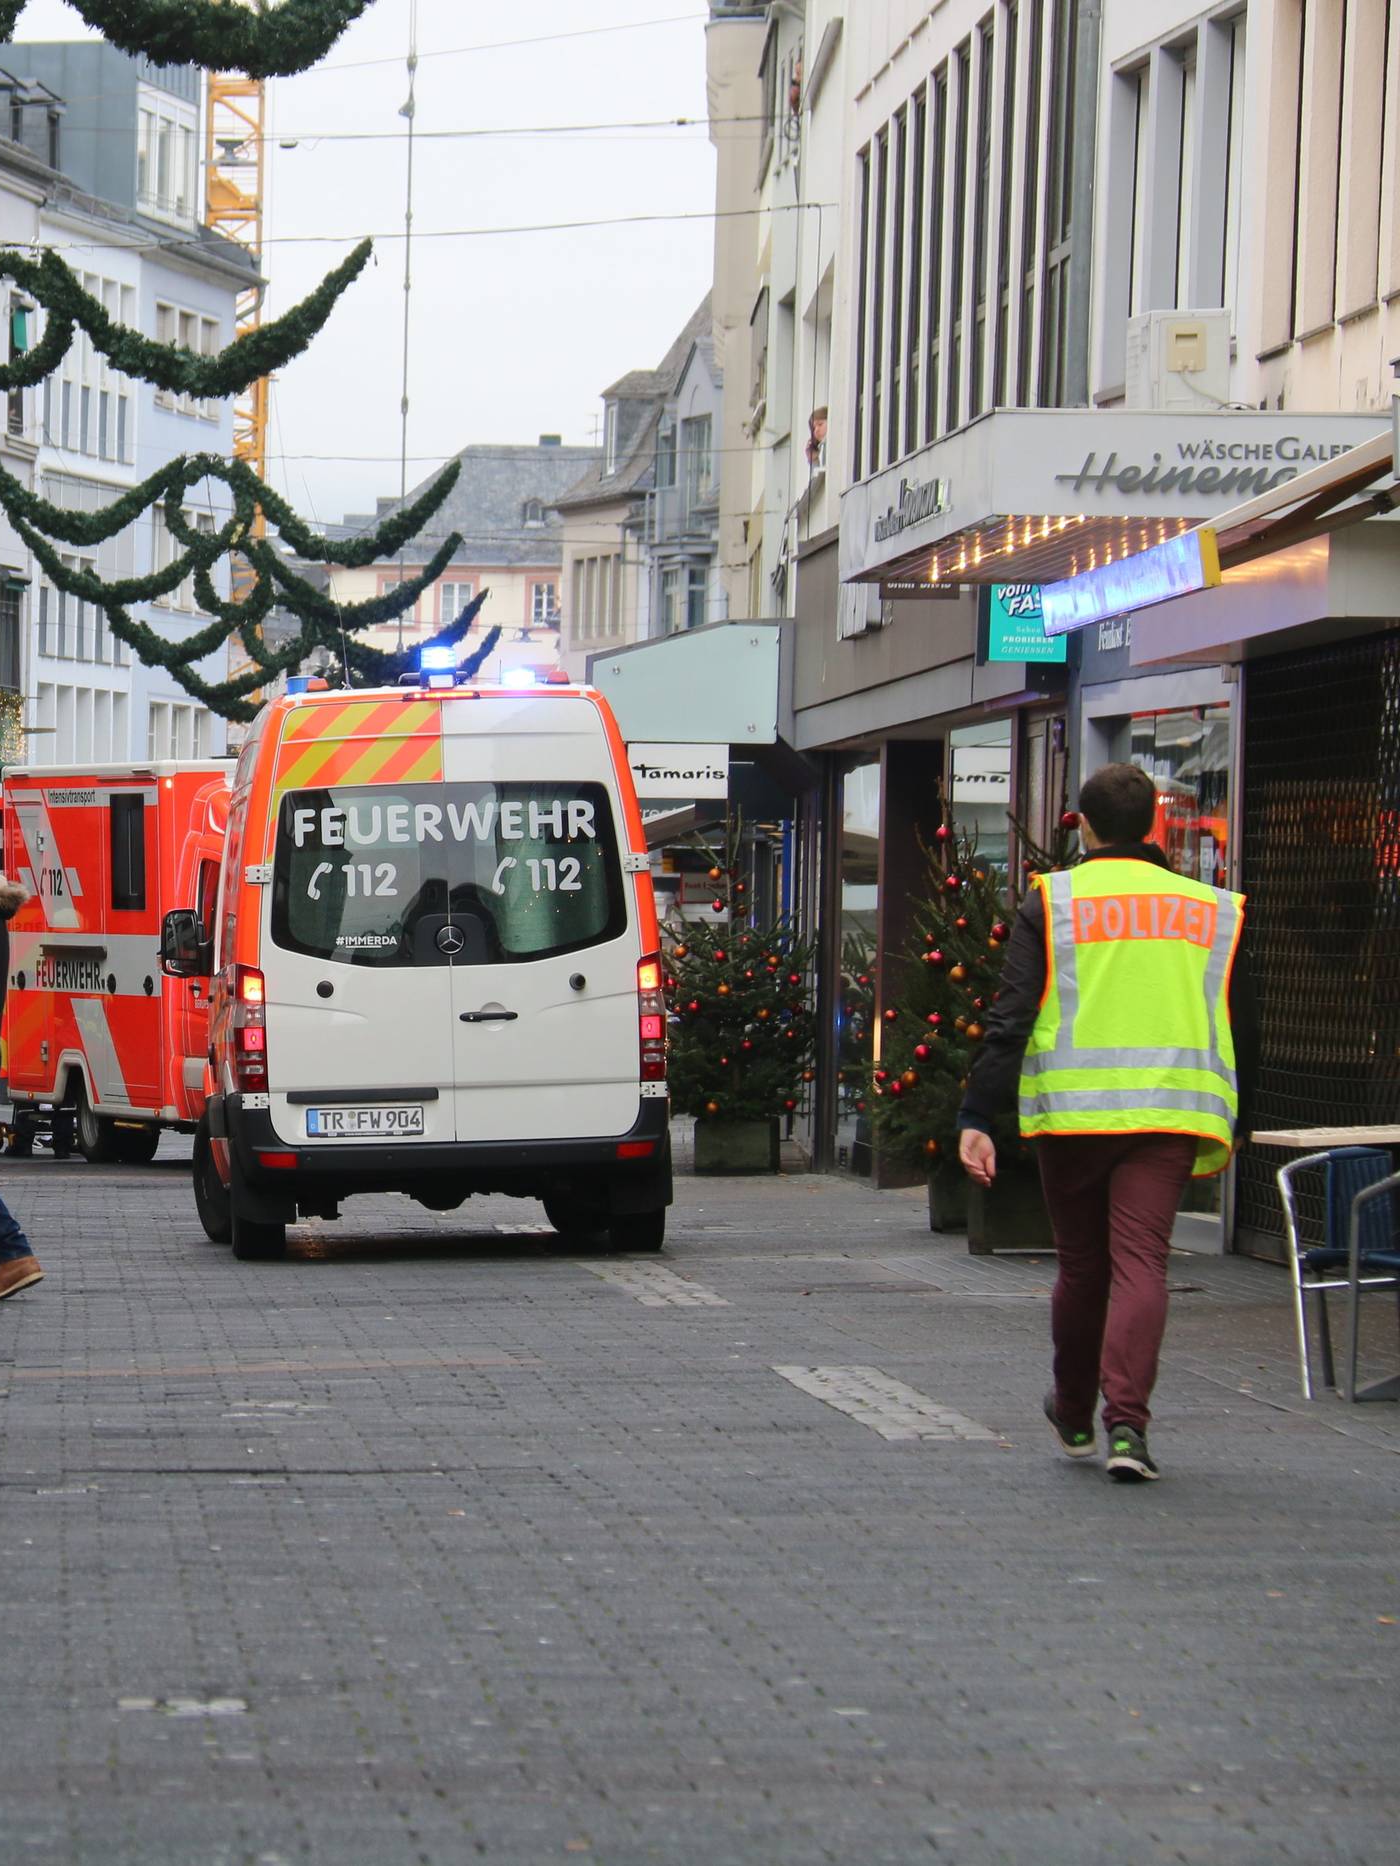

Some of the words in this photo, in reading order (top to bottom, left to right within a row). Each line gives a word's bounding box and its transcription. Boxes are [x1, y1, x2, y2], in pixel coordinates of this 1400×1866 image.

[1001, 645, 1055, 654] GENIESSEN
[1002, 635, 1055, 644] PROBIEREN
[47, 788, 96, 806] Intensivtransport
[293, 800, 597, 848] FEUERWEHR
[49, 868, 63, 897] 112
[341, 862, 399, 898] 112
[525, 856, 583, 892] 112
[1078, 896, 1212, 945] POLIZEI
[335, 934, 398, 946] #IMMERDA
[35, 959, 102, 990] FEUERWEHR
[320, 1112, 345, 1130] TR
[357, 1111, 381, 1129] FW
[386, 1110, 421, 1128] 904
